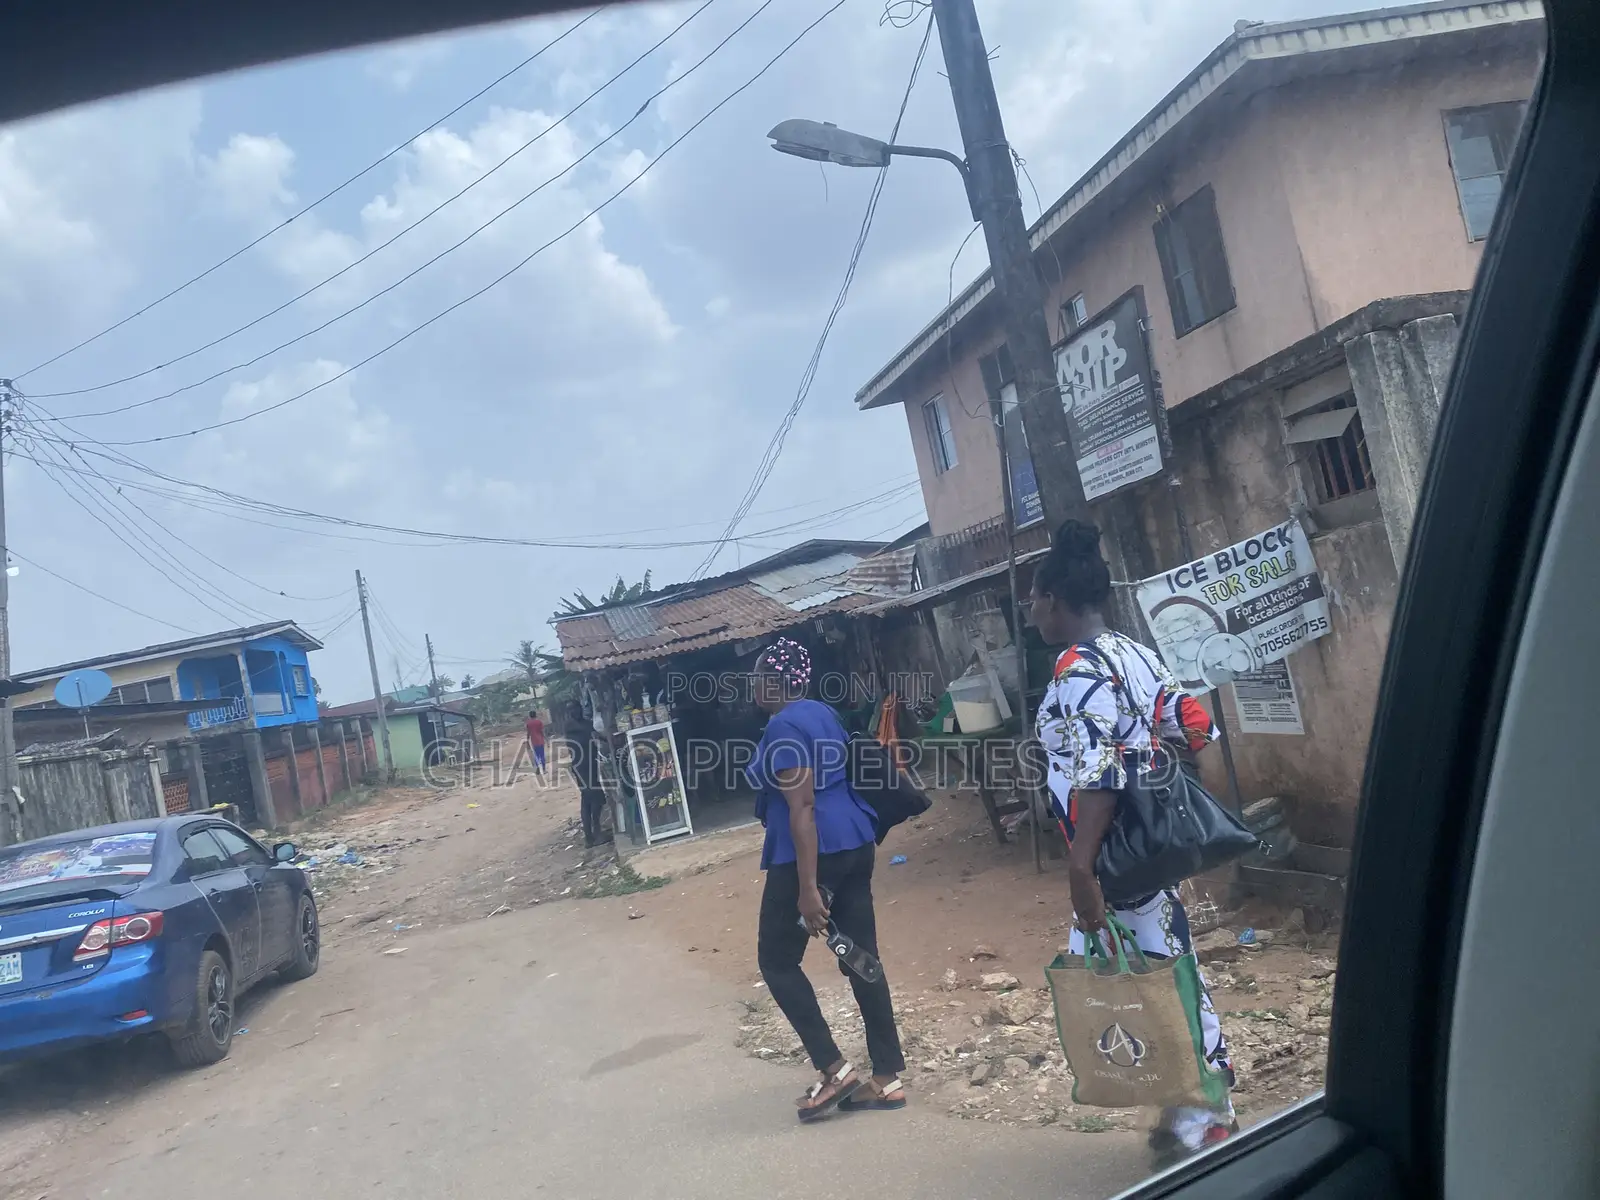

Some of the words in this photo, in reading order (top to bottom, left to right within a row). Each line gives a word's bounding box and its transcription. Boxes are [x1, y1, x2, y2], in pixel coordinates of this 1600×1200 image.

[1121, 388, 1145, 404] SERVICE
[1166, 560, 1209, 594] ICE
[1213, 524, 1294, 574] BLOCK
[1200, 573, 1247, 605] FOR
[1234, 604, 1253, 620] For
[1255, 598, 1271, 612] all
[1270, 585, 1298, 604] kinds
[1248, 593, 1305, 625] occassions
[1258, 626, 1280, 640] PLACE
[1279, 616, 1299, 631] ORDER
[68, 908, 105, 918] COROLLA
